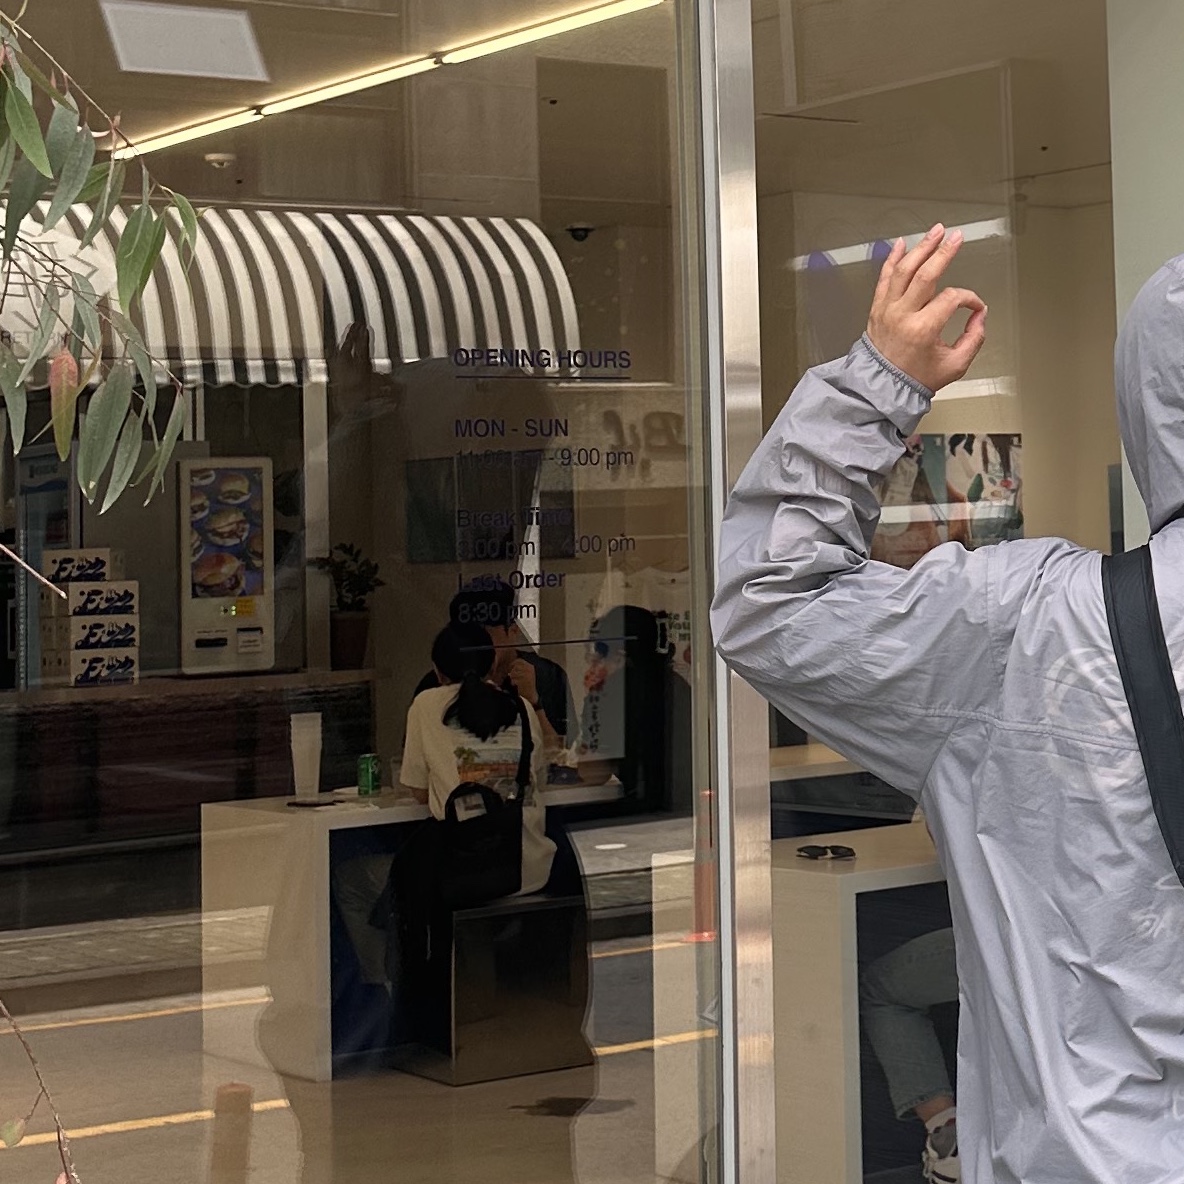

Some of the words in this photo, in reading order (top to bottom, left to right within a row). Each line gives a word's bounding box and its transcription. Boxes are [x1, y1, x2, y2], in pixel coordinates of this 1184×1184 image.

[453, 347, 552, 368] OPENING
[558, 349, 631, 369] HOURS
[454, 418, 505, 438] MON
[525, 418, 569, 437] SUN
[560, 447, 600, 467] 9:00
[606, 450, 634, 473] pm
[457, 509, 516, 528] Break
[523, 506, 573, 527] Time
[506, 539, 536, 562] pm
[563, 535, 602, 554] :00
[608, 536, 636, 556] pm
[458, 571, 503, 591] Last
[508, 570, 566, 589] Order
[458, 601, 501, 622] 8:30
[507, 603, 537, 624] pm
